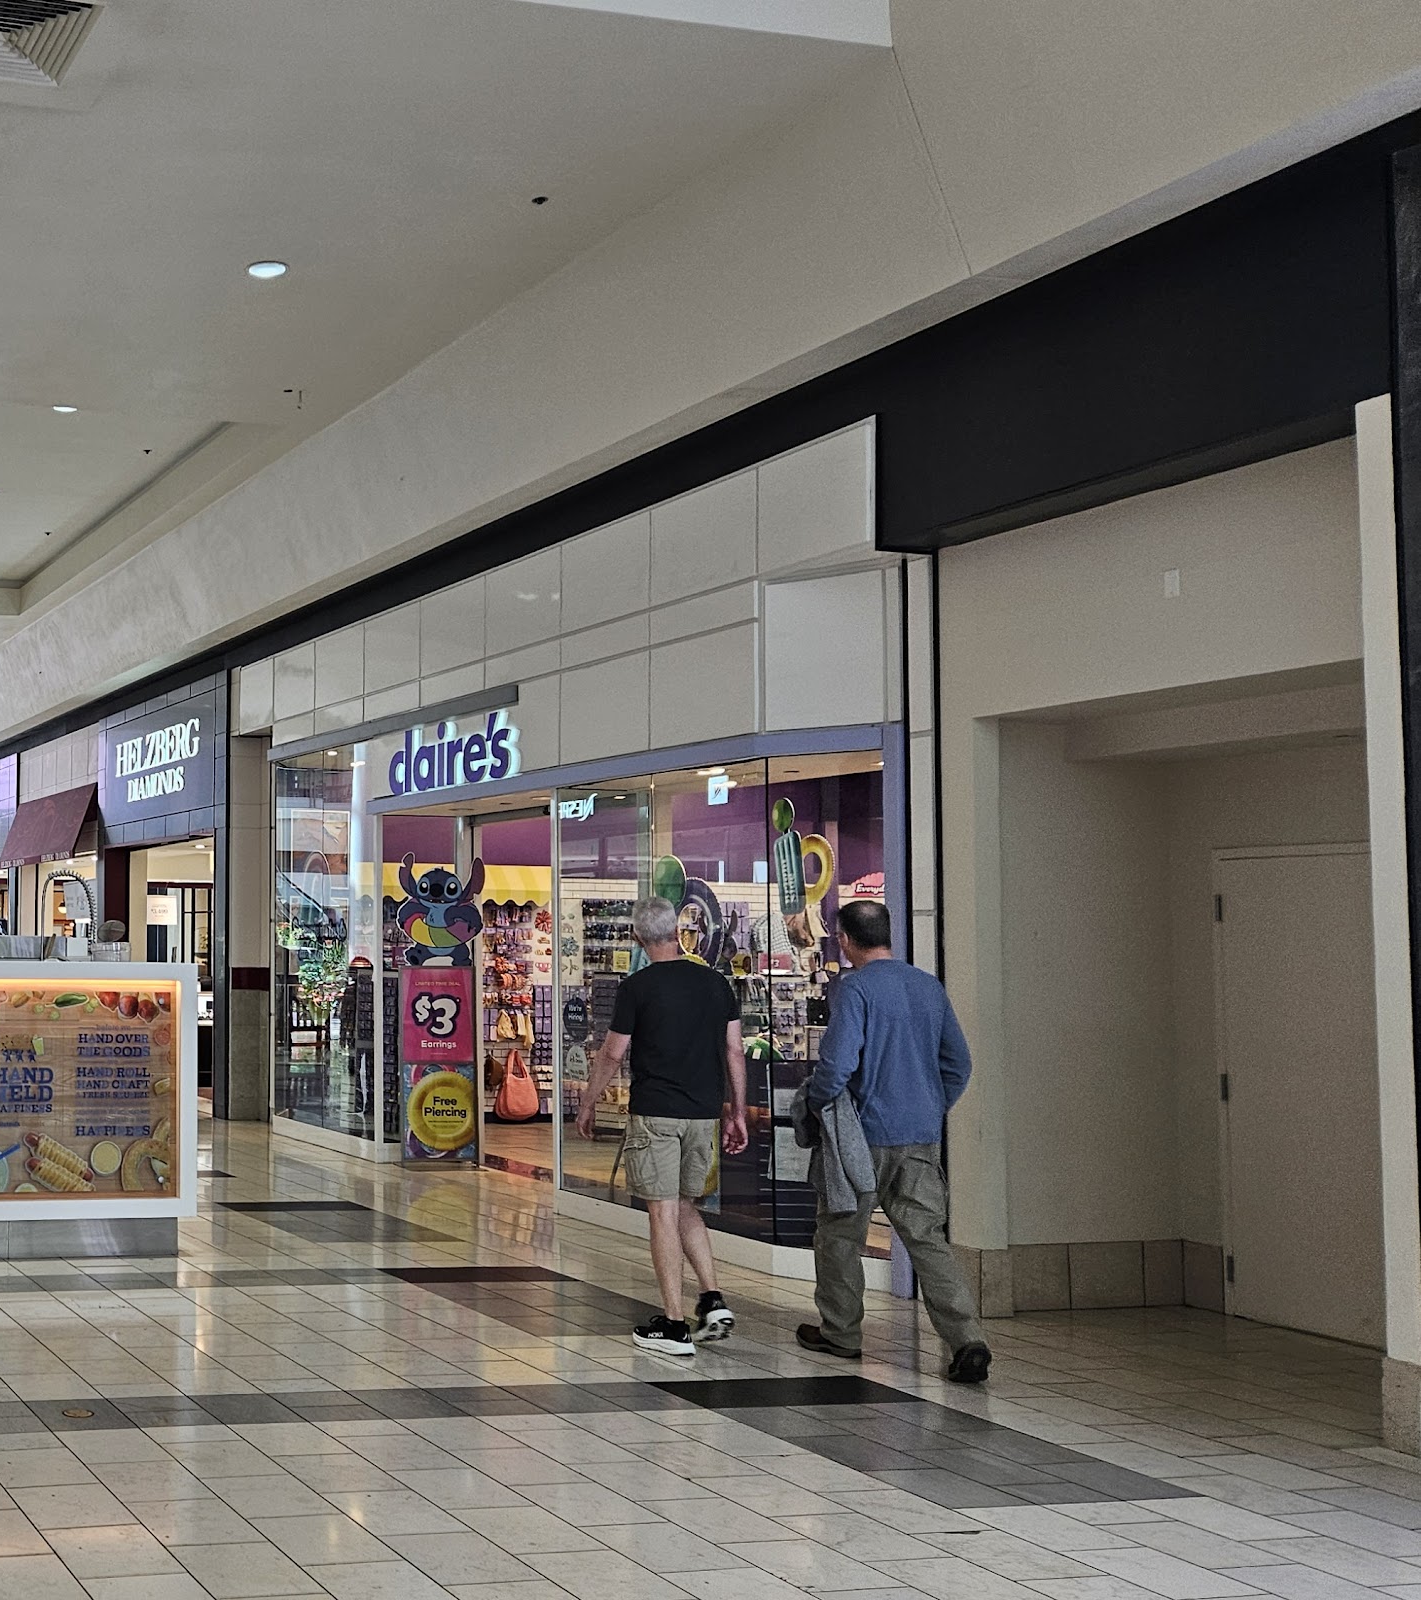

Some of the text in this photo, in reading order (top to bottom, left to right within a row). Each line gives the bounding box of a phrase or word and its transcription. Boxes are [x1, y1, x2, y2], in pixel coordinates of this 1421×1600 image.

[115, 717, 200, 778] HELZBERG
[388, 709, 514, 796] claire's
[126, 766, 185, 803] DIAMONDS
[568, 1004, 582, 1012] We're
[415, 995, 458, 1035] $3
[78, 1033, 149, 1044] HAND OVER
[421, 1039, 457, 1050] Earrings
[77, 1046, 150, 1057] THE GOODS
[77, 1067, 114, 1077] HAND
[76, 1079, 151, 1089] HAND CRAFT
[433, 1096, 457, 1106] Free
[424, 1106, 467, 1118] Piercing
[75, 1125, 151, 1137] HAPIES
